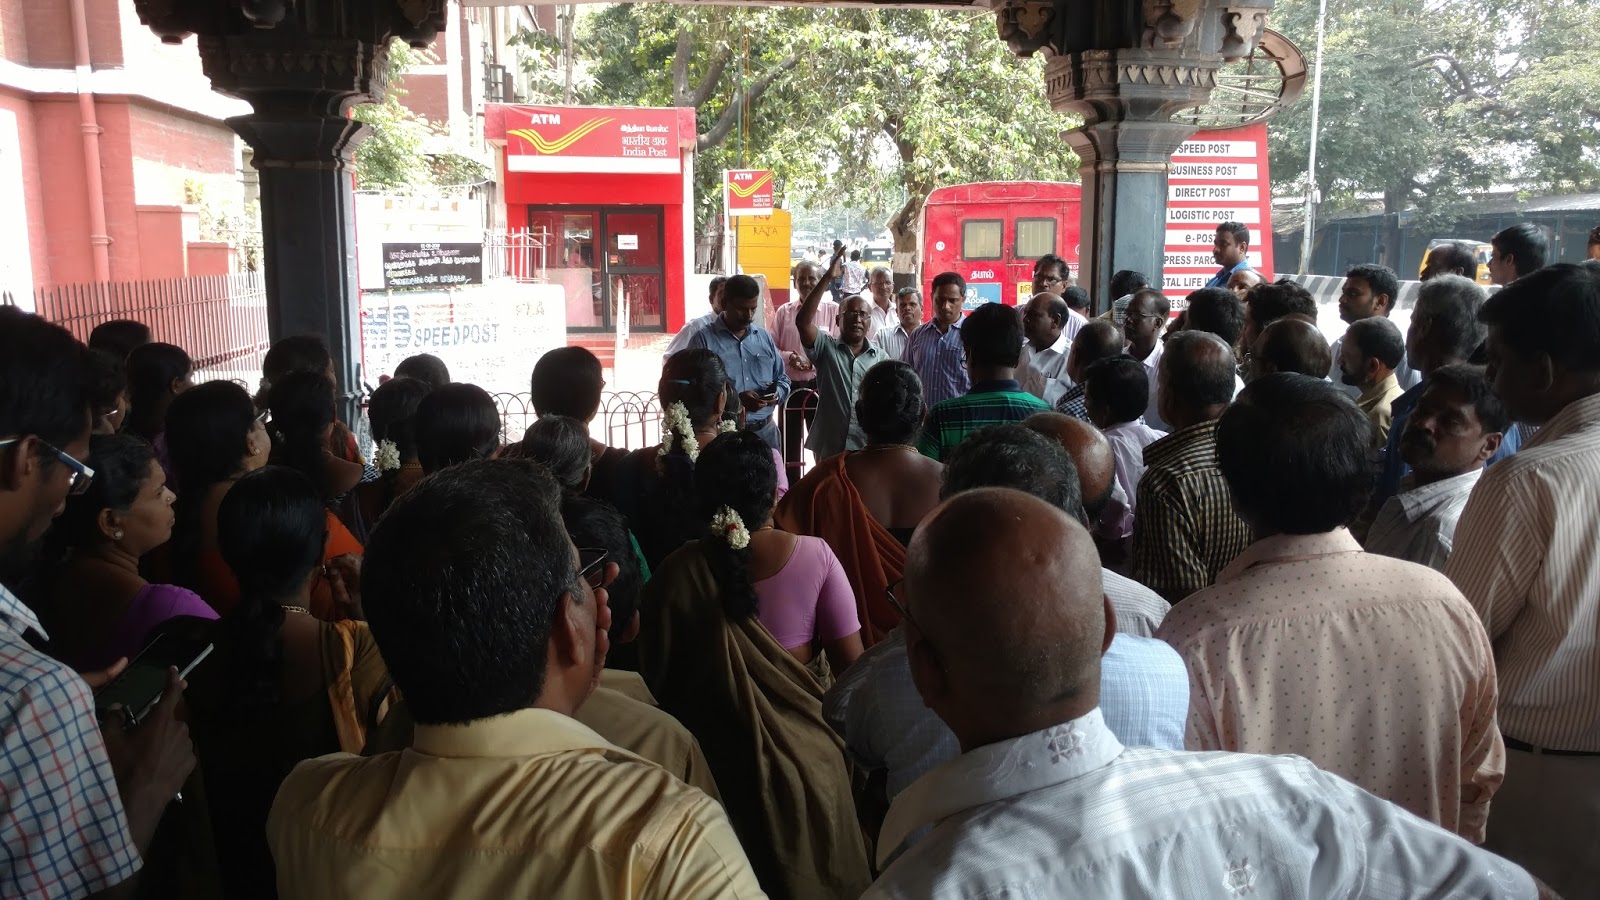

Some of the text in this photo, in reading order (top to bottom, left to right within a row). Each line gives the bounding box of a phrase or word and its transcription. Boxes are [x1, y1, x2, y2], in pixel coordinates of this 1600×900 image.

[531, 113, 561, 125] ATM
[621, 134, 668, 146] भारतीय डाक
[622, 146, 668, 157] India Post
[1178, 144, 1231, 154] SPEED POST
[1215, 166, 1238, 176] POST
[1175, 188, 1231, 198] DIRECT POST
[1170, 210, 1235, 220] LOGISTIC POST
[1164, 255, 1216, 265] PRESS PARC
[970, 269, 994, 280] தபால்
[1162, 277, 1181, 287] STAL
[1183, 277, 1202, 287] LIFE
[964, 296, 989, 306] Apollo
